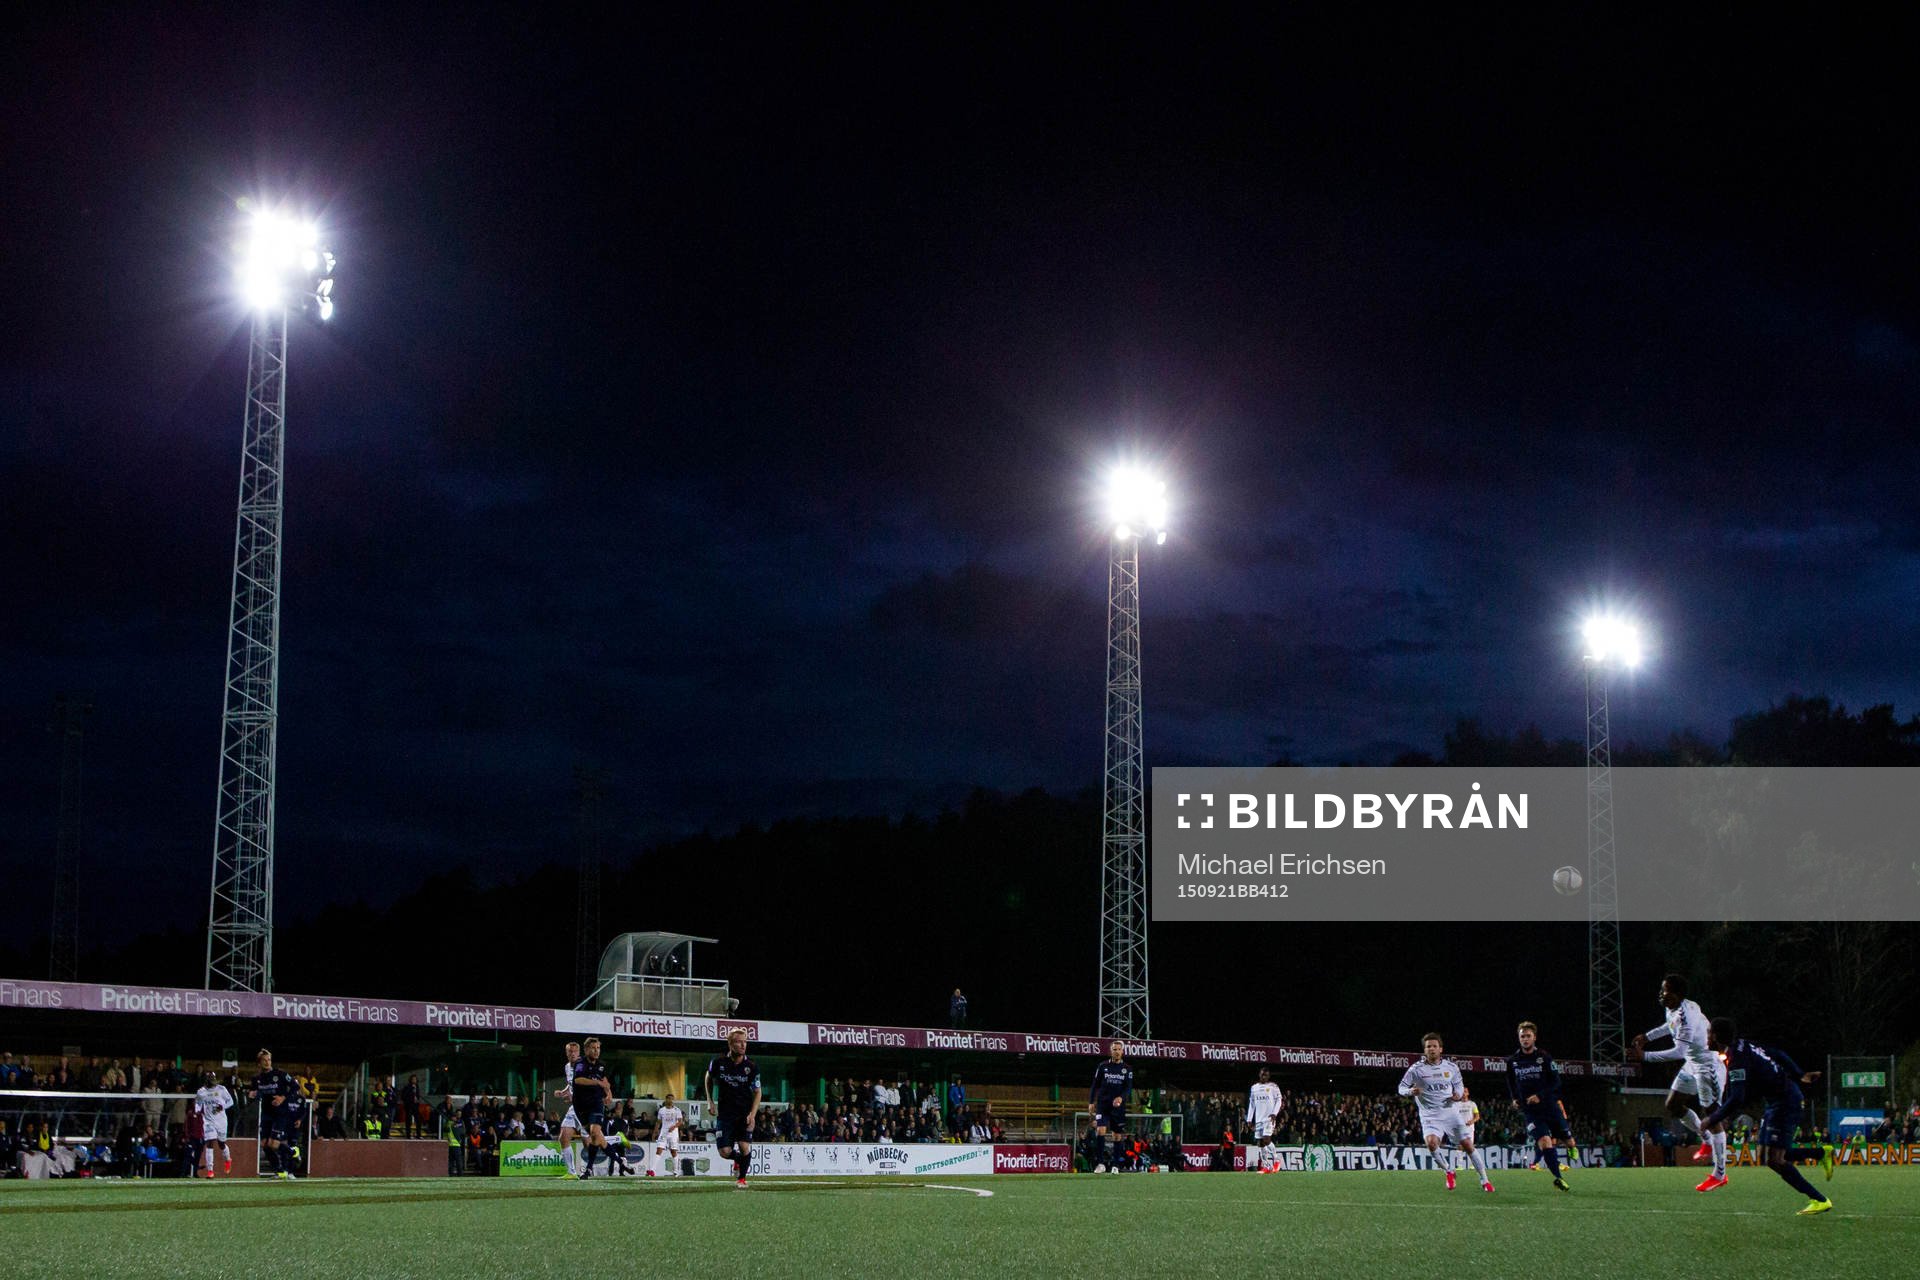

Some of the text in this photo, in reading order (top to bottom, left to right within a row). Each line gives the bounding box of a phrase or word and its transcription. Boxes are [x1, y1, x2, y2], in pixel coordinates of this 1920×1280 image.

[1, 983, 62, 1007] Finans
[101, 987, 241, 1015] Prioritet Finans
[273, 996, 398, 1022] Prioritet Finans
[426, 1004, 541, 1029] Prioritet Finans
[613, 1016, 671, 1035] Prioritet
[674, 1020, 715, 1037] Finans
[818, 1025, 906, 1047] Prioritet Finans
[926, 1031, 1007, 1050] Prioritet Finans
[1026, 1035, 1100, 1054] Prioritet Finans
[1158, 1043, 1186, 1058] Finans
[1202, 1045, 1267, 1062] Prioritet Finans
[1280, 1048, 1340, 1065] Prioritet Finans
[1354, 1052, 1386, 1067] Prioritet
[1387, 1055, 1409, 1068] Finans
[1427, 1083, 1449, 1091] ABRO
[691, 1105, 699, 1115] M
[503, 1152, 567, 1169] Ångtvättbile
[867, 1147, 909, 1164] MÜRBECKS
[996, 1153, 1068, 1168] Prioritet Finans
[1335, 1151, 1378, 1170] TIFO
